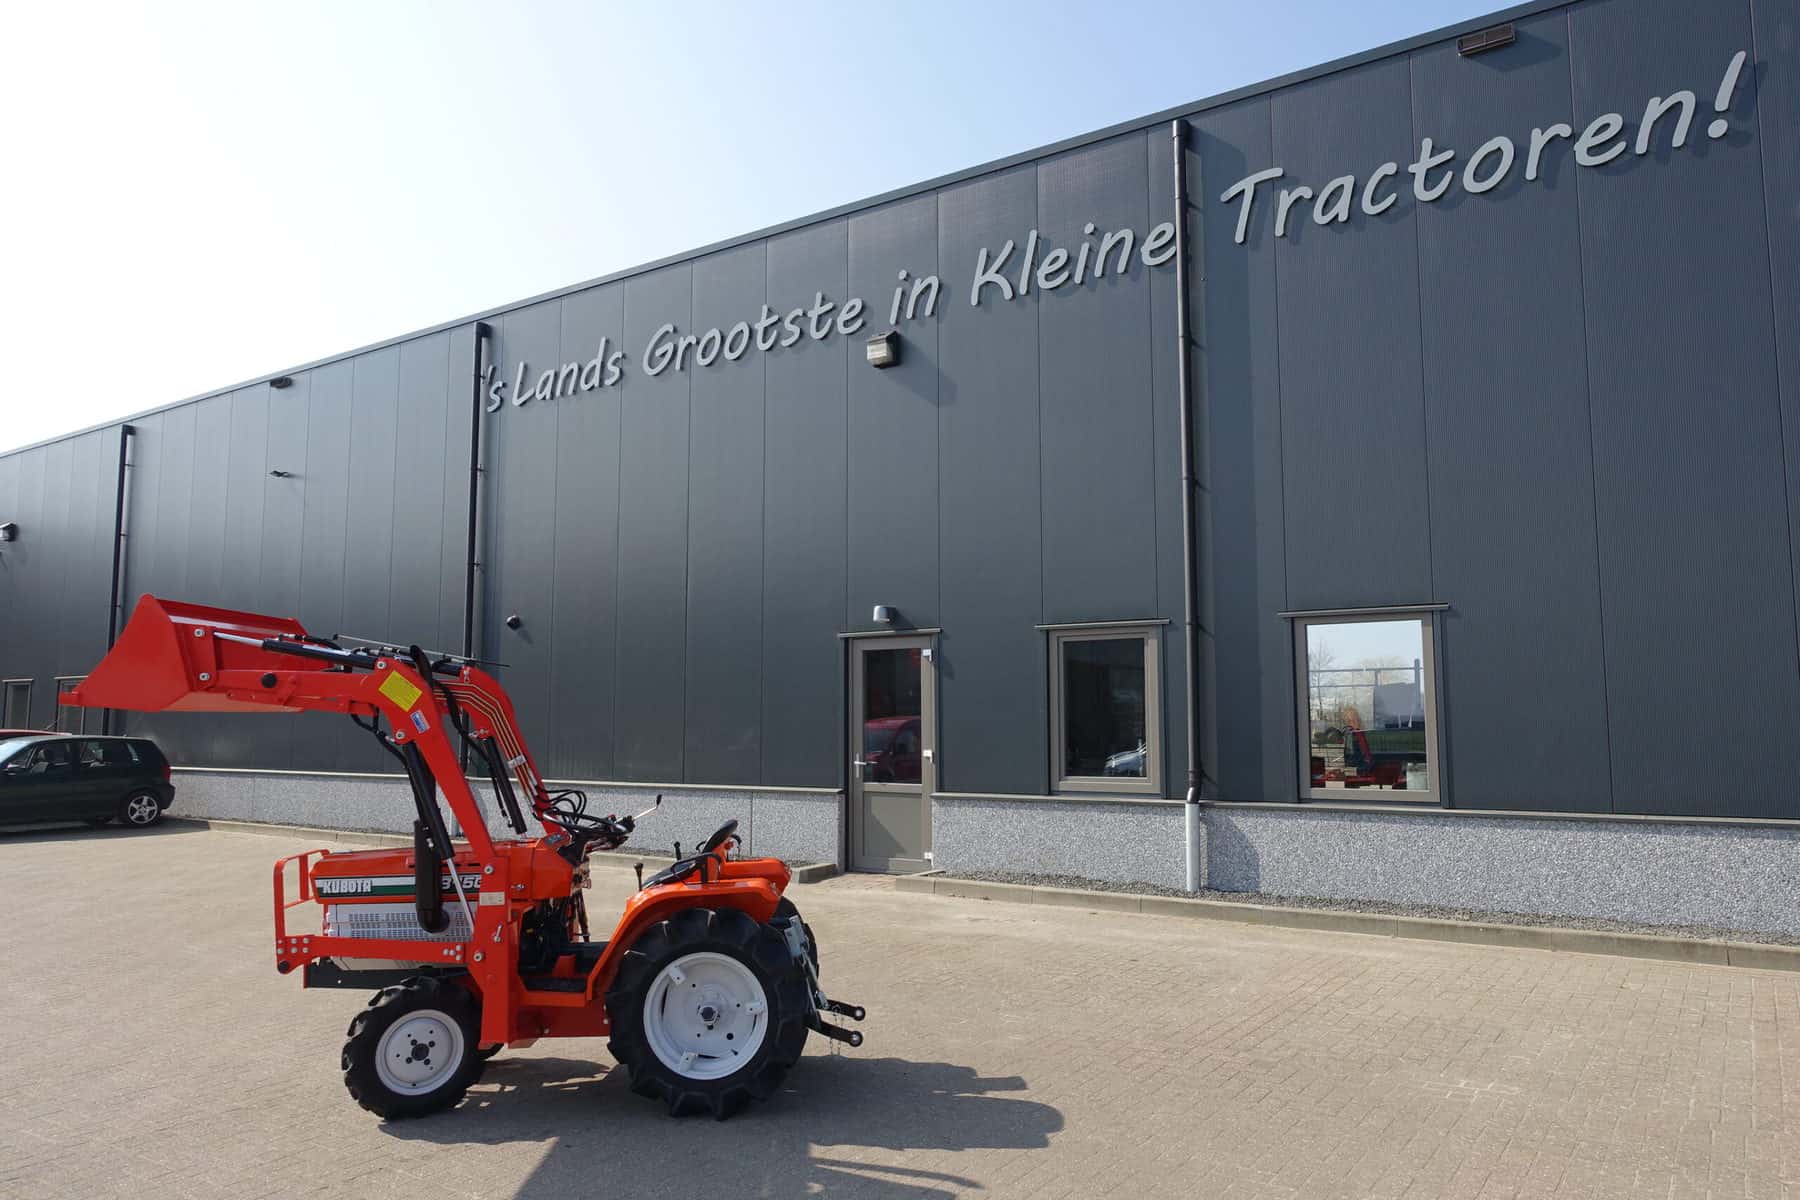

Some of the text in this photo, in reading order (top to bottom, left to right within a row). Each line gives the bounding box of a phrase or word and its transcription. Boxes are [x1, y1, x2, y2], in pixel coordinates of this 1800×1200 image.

[511, 336, 624, 407] Lands
[641, 291, 864, 376] Grootste
[888, 269, 940, 325] in
[970, 221, 1177, 306] Kleine
[1220, 50, 1747, 244] Tractoren!
[322, 879, 372, 894] KUBOTA
